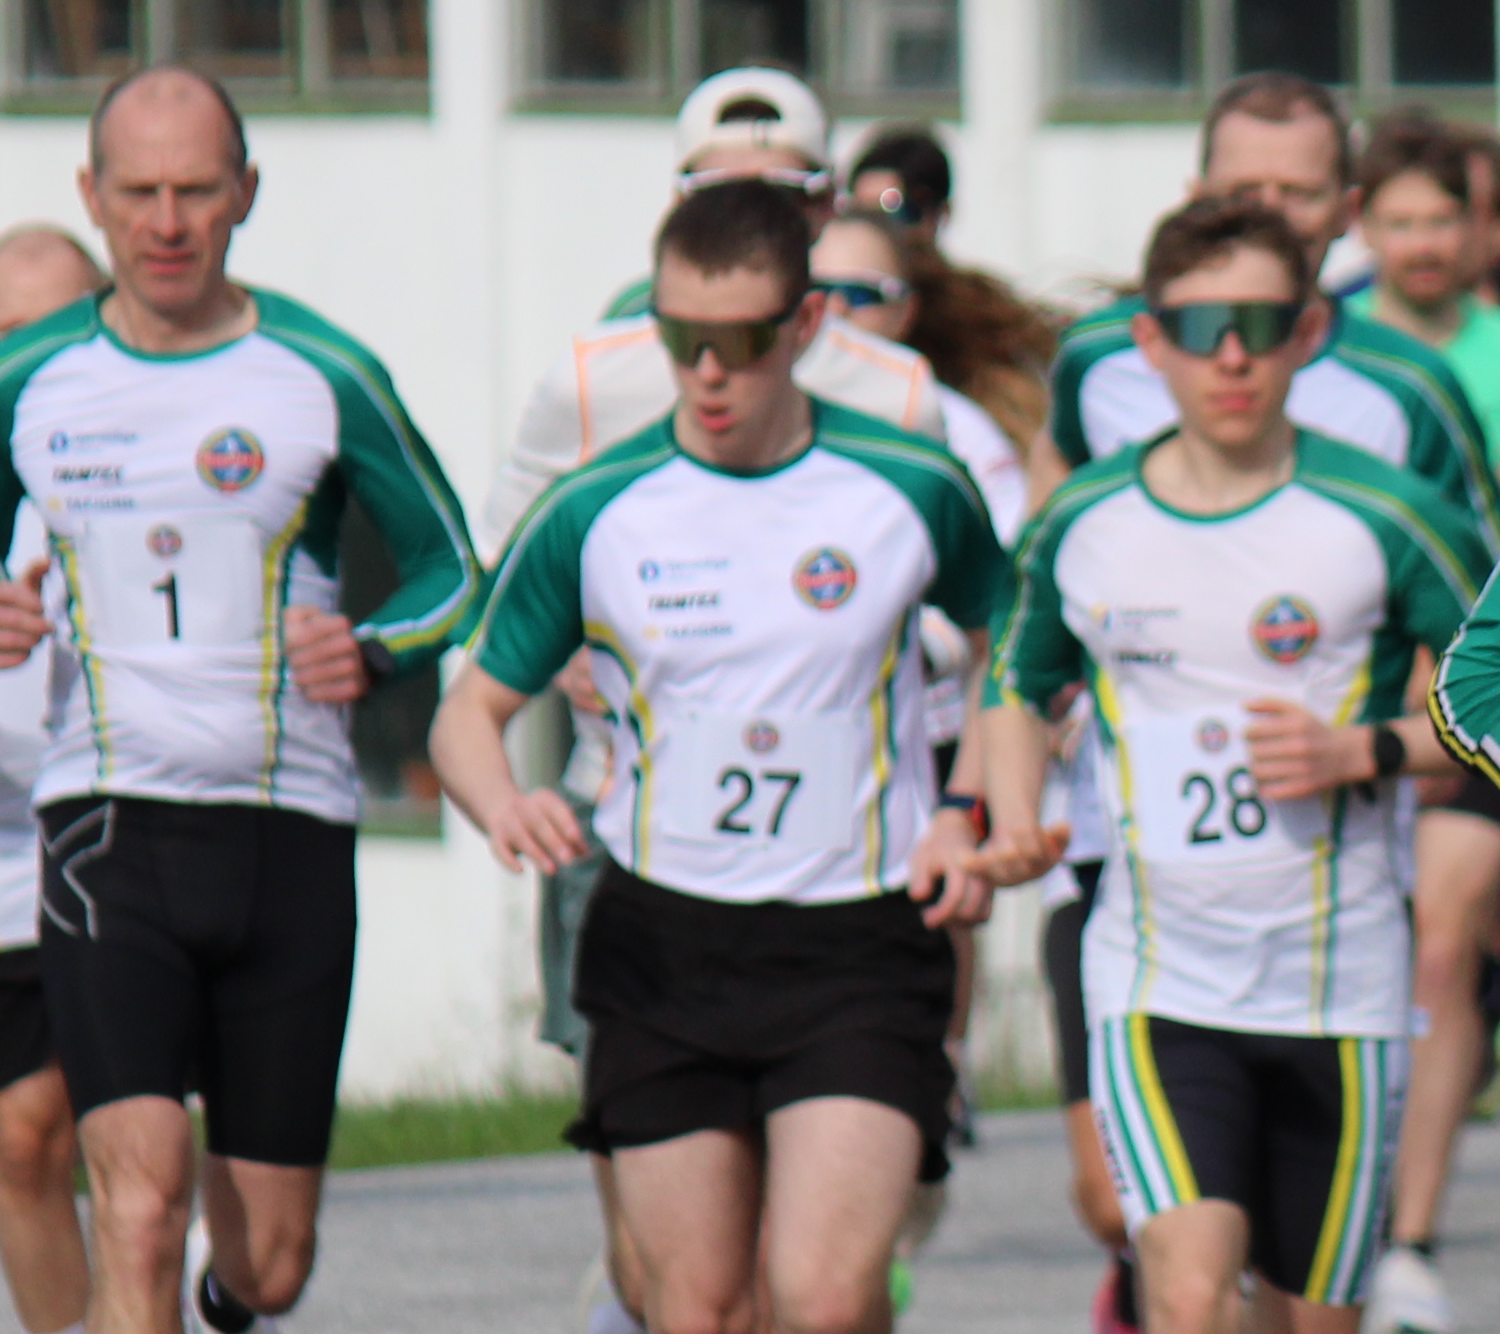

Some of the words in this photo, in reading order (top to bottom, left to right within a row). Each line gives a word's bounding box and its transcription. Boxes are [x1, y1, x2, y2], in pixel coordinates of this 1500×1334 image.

[153, 572, 179, 640] 1
[716, 765, 801, 835] 27
[1181, 767, 1268, 844] 28
